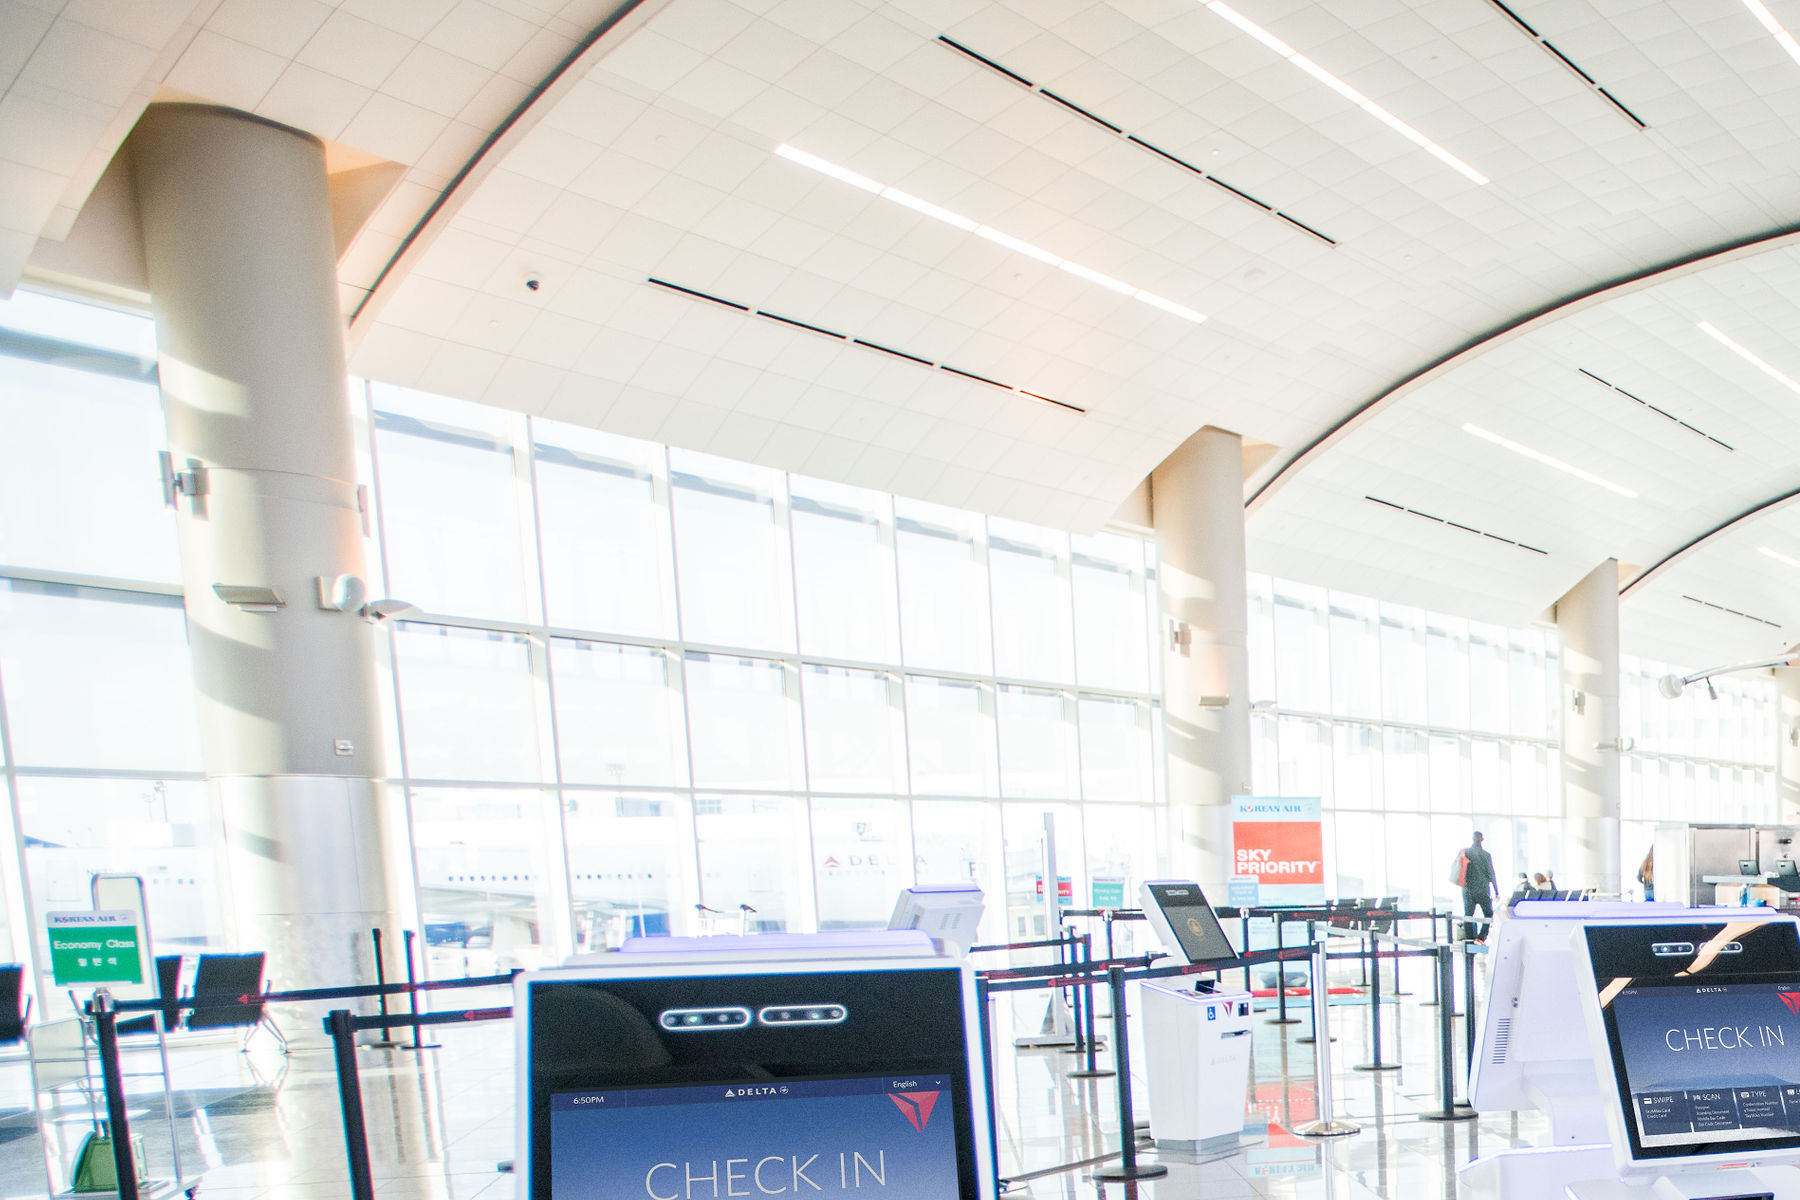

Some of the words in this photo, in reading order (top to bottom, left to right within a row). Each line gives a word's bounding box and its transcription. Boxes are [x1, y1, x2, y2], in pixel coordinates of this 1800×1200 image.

[1239, 804, 1280, 813] KOREAN
[1283, 804, 1302, 813] AIR
[1236, 848, 1272, 862] SKY
[849, 855, 928, 867] DELA
[1237, 861, 1317, 874] PRIORITY
[53, 940, 102, 951] Economy
[105, 939, 135, 949] Class
[1665, 1026, 1754, 1052] CHECK
[1758, 1025, 1785, 1047] IN
[893, 1079, 918, 1090] English
[738, 1086, 777, 1097] DELTA
[1750, 1090, 1767, 1098] TYPE
[573, 1095, 605, 1105] 6:50PM
[1653, 1096, 1674, 1104] SWIPE
[839, 1149, 886, 1189] IN
